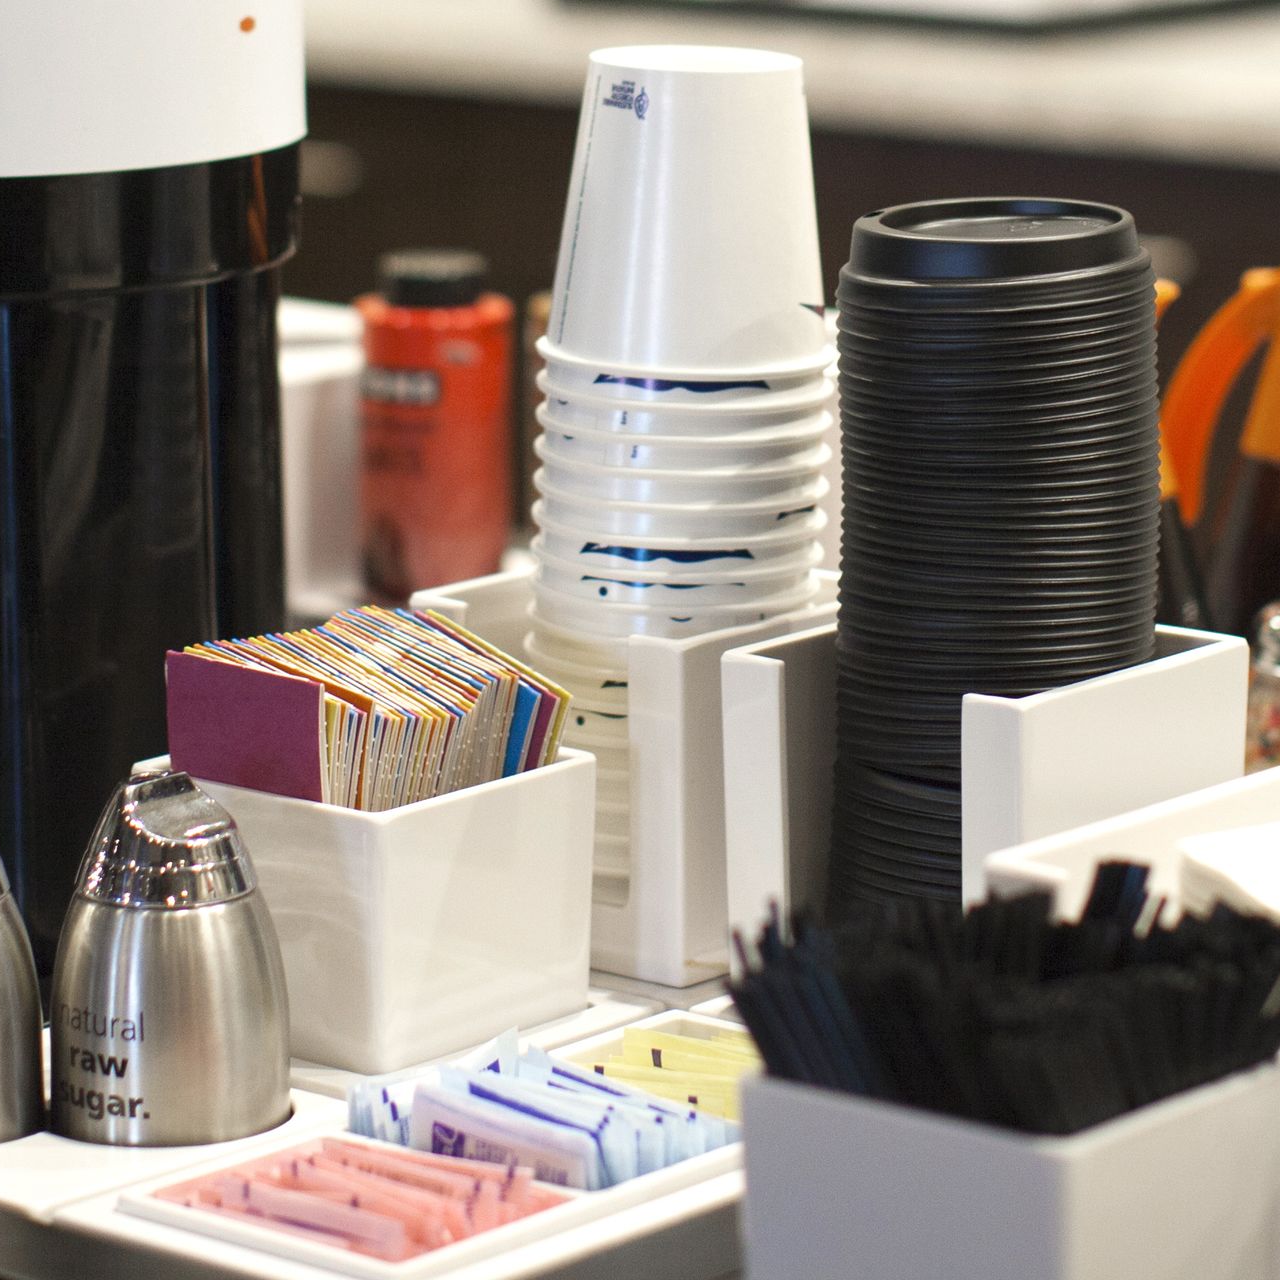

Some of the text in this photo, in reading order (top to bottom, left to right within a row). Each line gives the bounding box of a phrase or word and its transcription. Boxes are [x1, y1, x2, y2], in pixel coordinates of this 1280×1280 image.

[60, 1004, 144, 1042] natural
[70, 1045, 129, 1078] raw
[61, 1080, 151, 1121] sugar.
